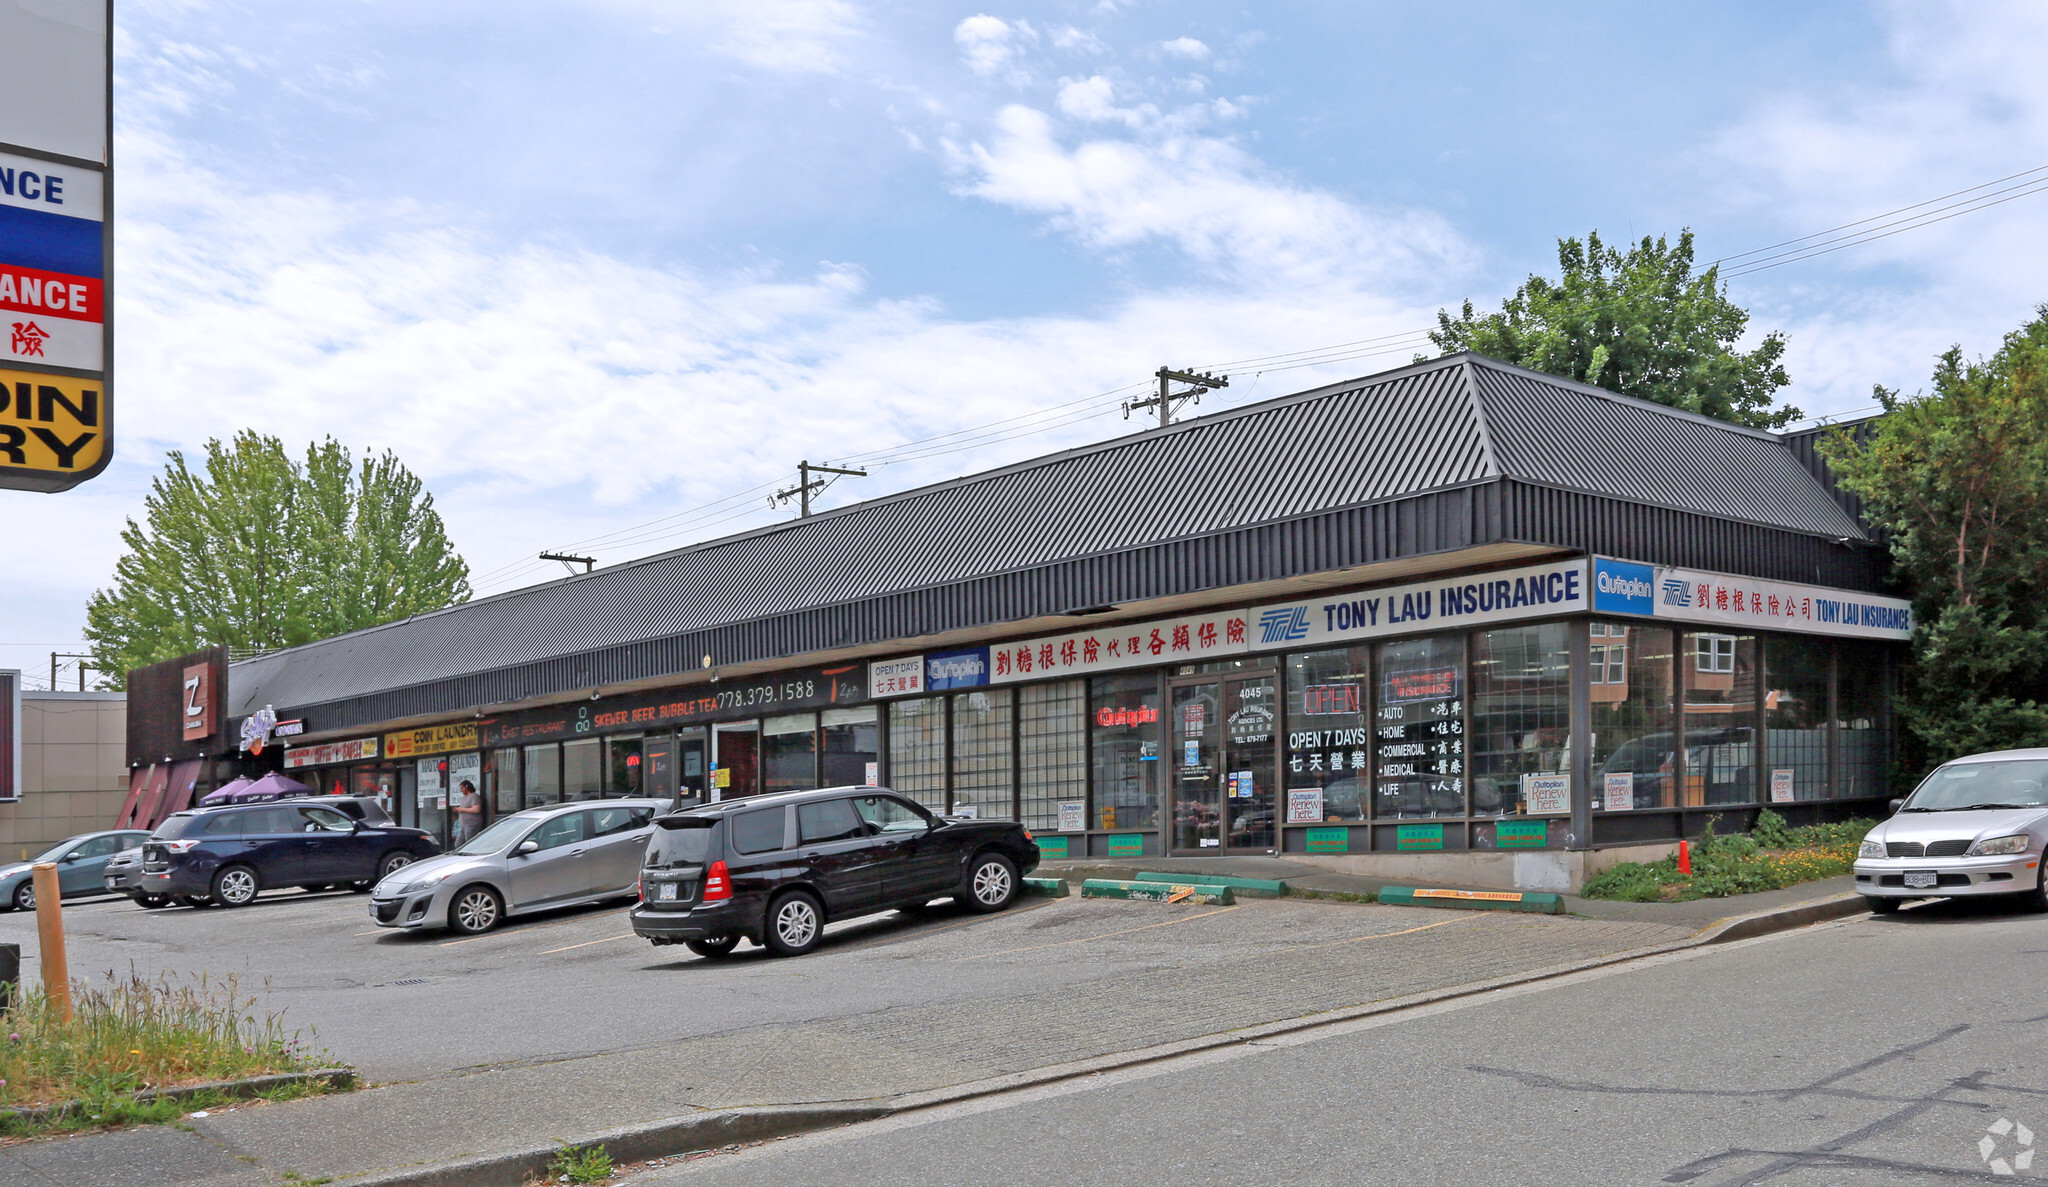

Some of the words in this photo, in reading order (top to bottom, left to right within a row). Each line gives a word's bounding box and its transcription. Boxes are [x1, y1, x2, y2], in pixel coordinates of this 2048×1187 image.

[12, 321, 50, 357] 險
[0, 382, 98, 427] IN
[1324, 598, 1380, 632] TONY
[1389, 590, 1431, 625] LAU
[1440, 570, 1579, 617] INSURANCE
[1816, 599, 1840, 623] TONY
[1842, 602, 1859, 626] LAU
[1861, 605, 1909, 630] INSURANCE
[876, 665, 894, 677] OPEN
[895, 664, 900, 673] 7
[901, 661, 919, 672] DAYS
[876, 676, 919, 694] 七天營業
[717, 680, 814, 709] 778.379.1588
[1240, 687, 1261, 699] 4045
[1306, 686, 1359, 713] OPEN
[594, 711, 628, 728] SKEWER
[632, 706, 656, 722] BEER
[659, 701, 695, 719] BUBBLE
[698, 698, 718, 712] TEA
[1228, 710, 1240, 724] TONY
[1240, 706, 1249, 715] LAU
[1250, 706, 1273, 721] INSURANCE
[1383, 707, 1403, 720] AUTO
[414, 729, 433, 744] COIN
[437, 723, 478, 740] LAUNDRY
[1289, 732, 1321, 749] OPEN
[1325, 730, 1331, 746] 7
[1335, 728, 1365, 747] DAYS
[1383, 726, 1404, 739] HOME
[1383, 743, 1426, 757] COMMERCIAL
[1289, 750, 1365, 773] 七天營業
[1383, 763, 1416, 776] MEDICAL
[1383, 783, 1399, 795] LIFE
[1531, 787, 1567, 799] Renew
[1607, 784, 1631, 796] Renew
[1291, 798, 1319, 810] Renew
[1536, 797, 1561, 810] here.
[1610, 795, 1627, 807] here.
[1061, 810, 1084, 821] Renew
[1294, 807, 1314, 819] here.
[1064, 820, 1080, 828] here.
